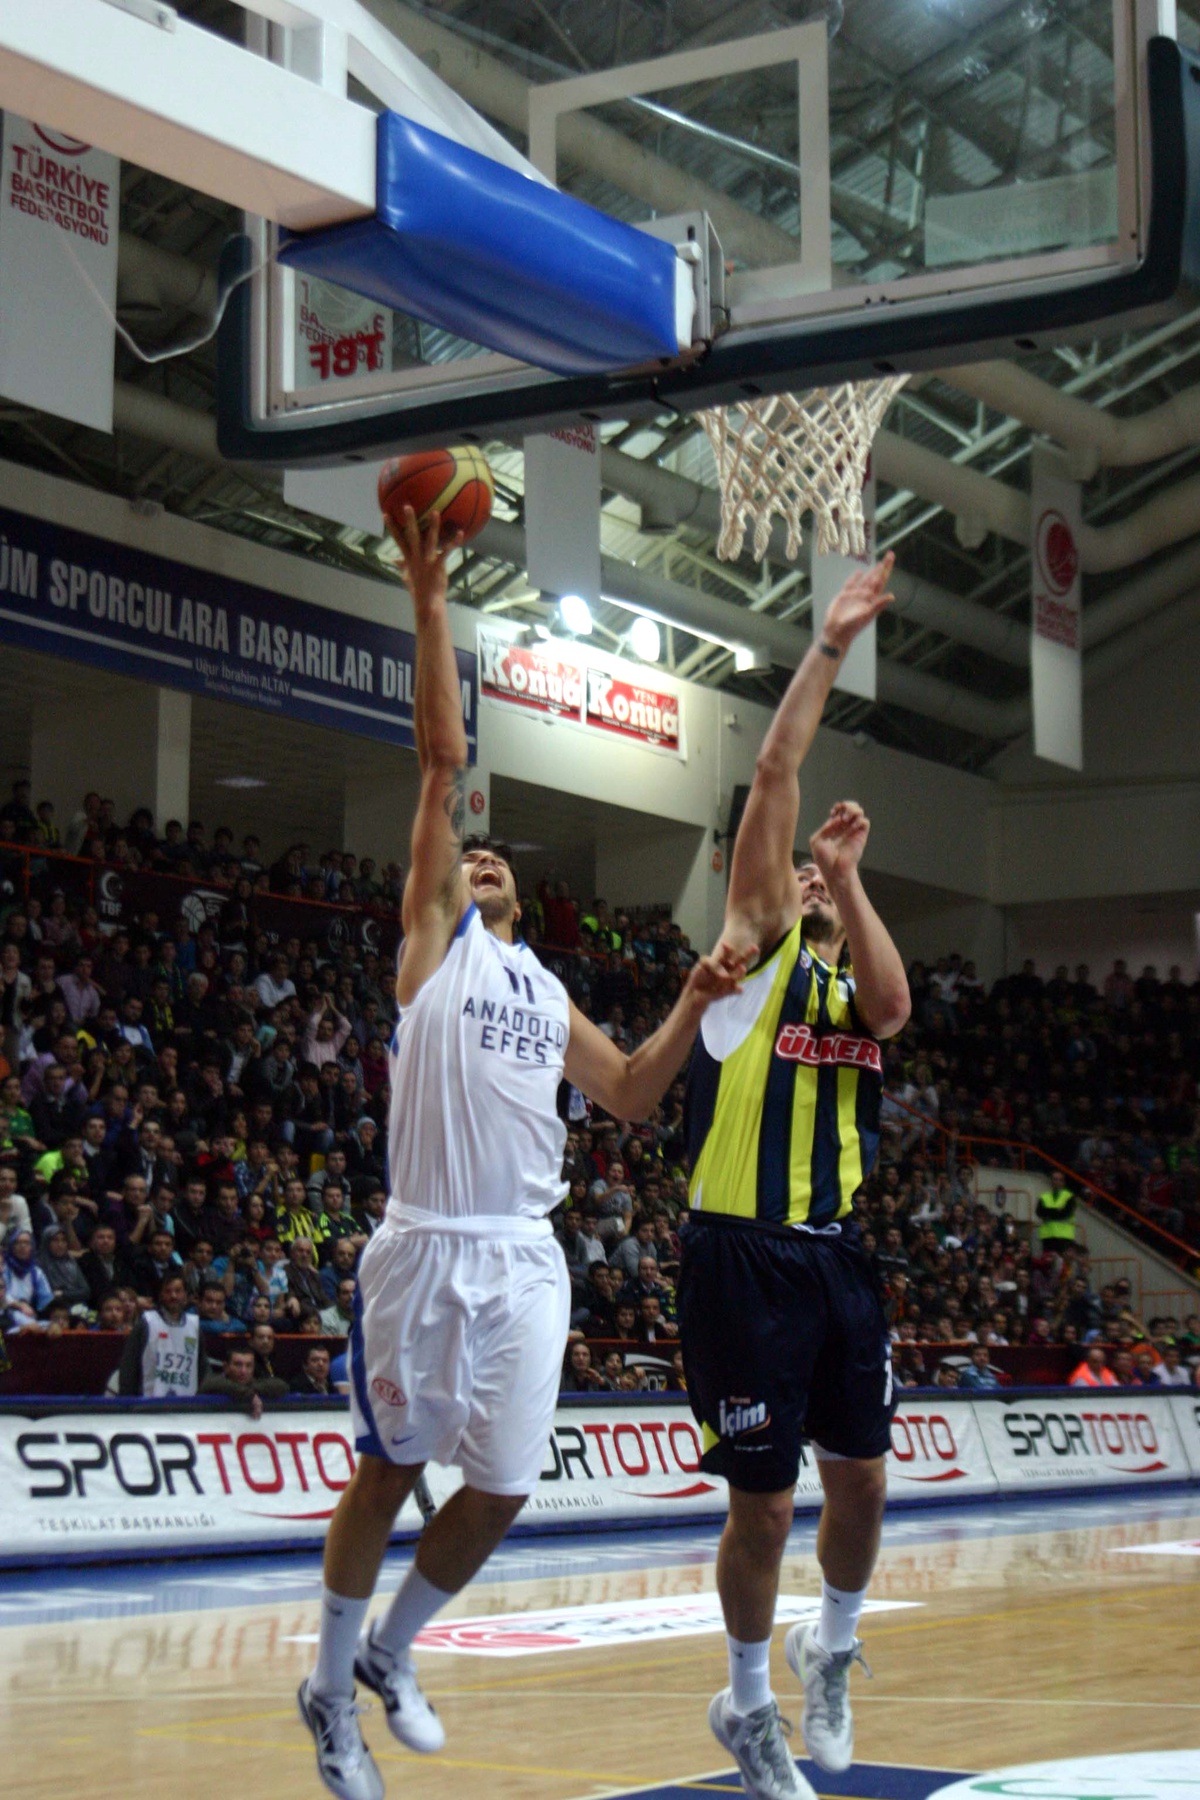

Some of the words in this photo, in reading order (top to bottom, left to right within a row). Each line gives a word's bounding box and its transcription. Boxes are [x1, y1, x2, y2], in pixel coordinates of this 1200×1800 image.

[11, 172, 109, 230] BASKETBOL
[50, 559, 230, 654] SPORCULARA
[239, 614, 373, 694] BAŞARILAR
[462, 997, 563, 1048] ANADOLU
[481, 1025, 547, 1065] EFES
[776, 1024, 882, 1071] ÜLKER
